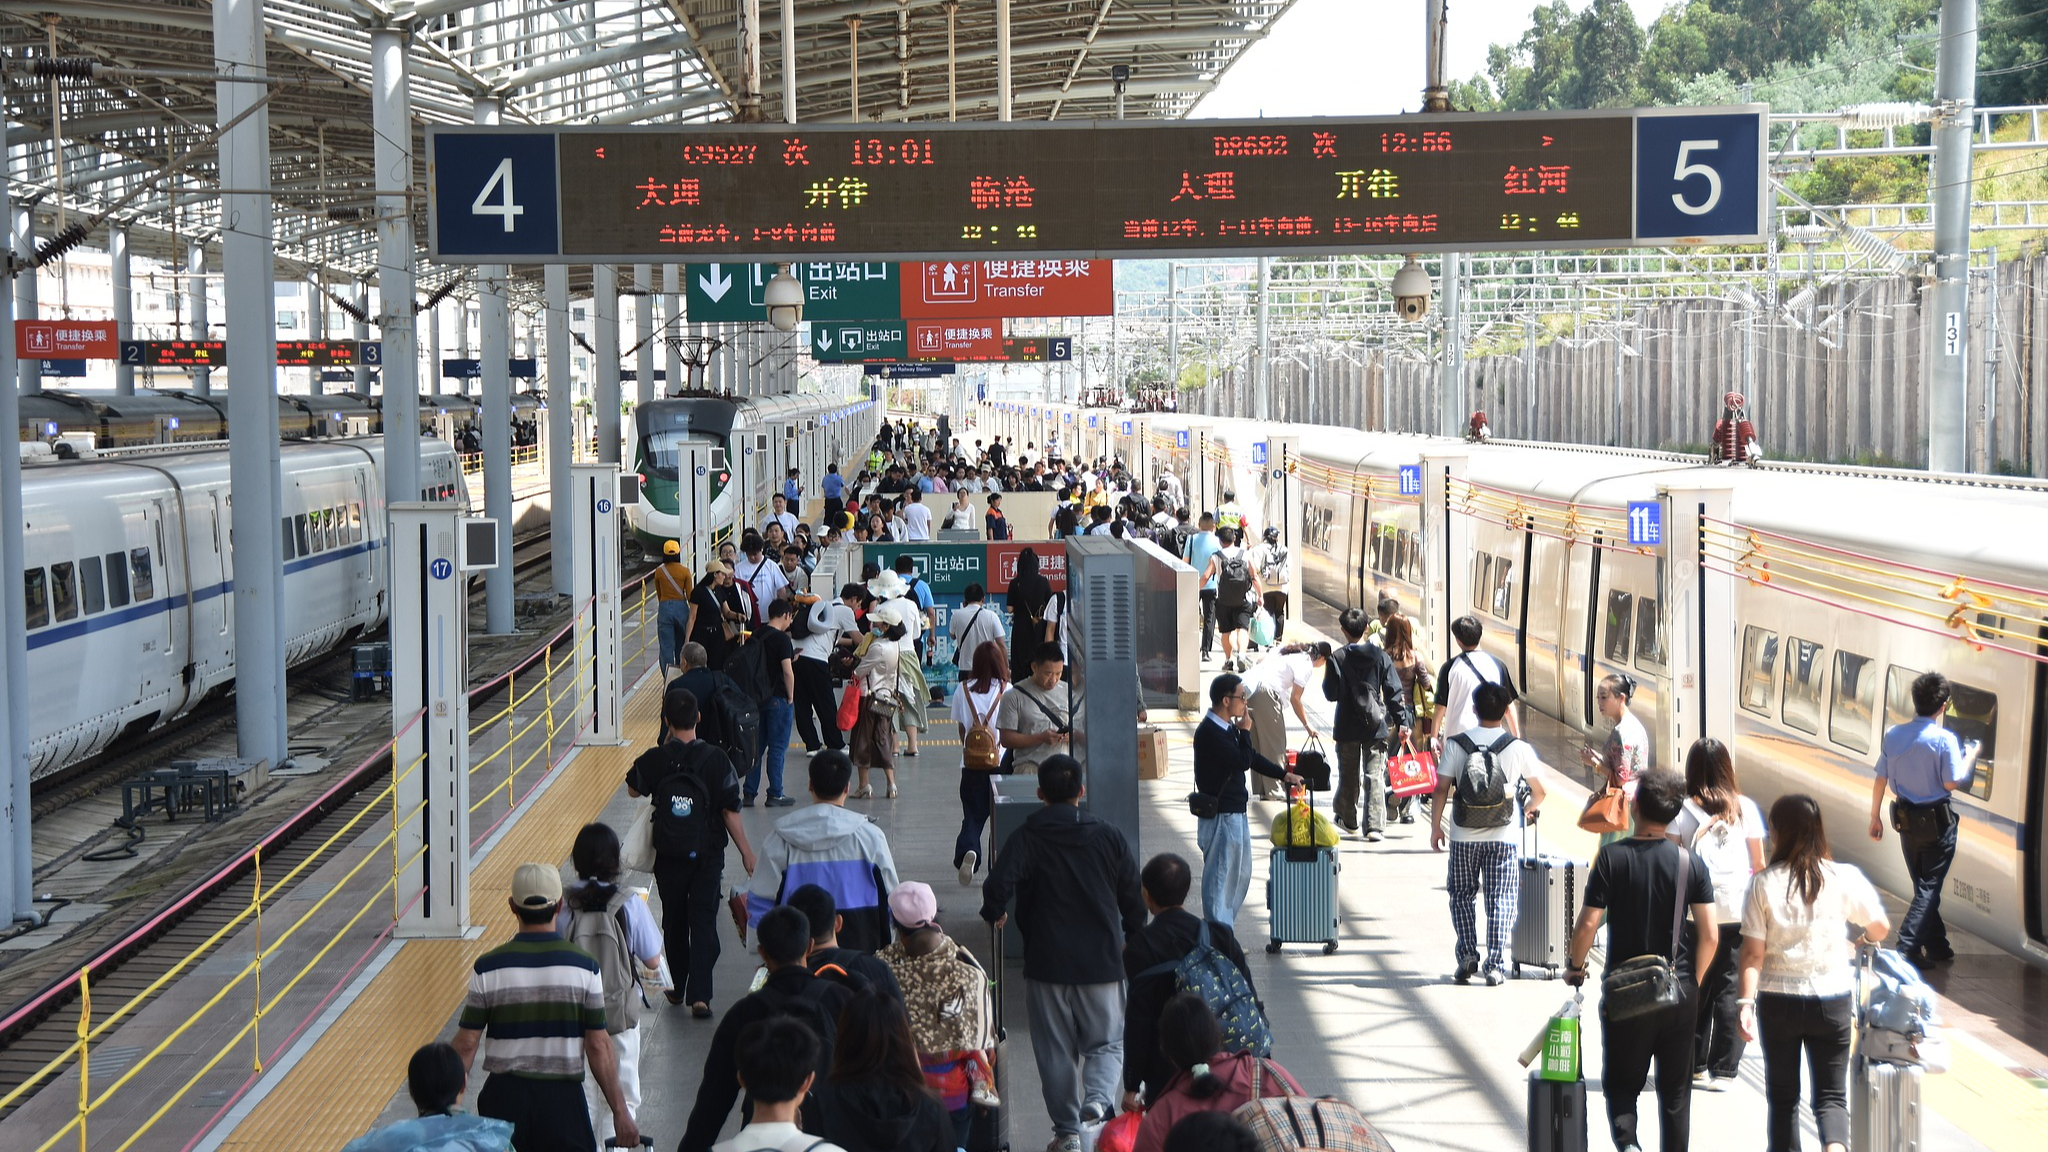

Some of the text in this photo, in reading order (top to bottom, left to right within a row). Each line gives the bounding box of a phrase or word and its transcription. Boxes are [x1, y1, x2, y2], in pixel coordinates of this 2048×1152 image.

[1213, 134, 1288, 156] D8682
[1380, 130, 1451, 152] 12:56
[851, 138, 934, 165] 13:01
[1335, 169, 1400, 198] 开往
[1503, 165, 1570, 194] 红河
[1671, 139, 1722, 216] 5
[472, 157, 524, 232] 4
[635, 176, 699, 210] 大理
[804, 175, 868, 209] 开往
[809, 262, 887, 281] 出站口
[983, 261, 1090, 279] 便捷换乘
[809, 286, 837, 300] Exit
[984, 284, 1045, 298] Transfer
[55, 329, 107, 342] 便捷换乘
[866, 330, 902, 342] 出站口
[944, 327, 993, 340] 便捷换乘
[1947, 313, 1958, 354] 131
[867, 343, 880, 351] Exit
[945, 341, 973, 350] Transfer
[1055, 342, 1066, 357] 5
[127, 346, 138, 361] 2
[367, 346, 377, 361] 3
[697, 467, 705, 475] 15
[1400, 468, 1420, 493] 11车
[599, 501, 609, 512] 16
[1630, 506, 1659, 542] 11车
[433, 561, 448, 577] 17
[934, 556, 980, 571] 出站口
[1037, 555, 1065, 571] 便捷
[934, 573, 951, 583] Exit
[671, 795, 694, 806] NASA
[1549, 1028, 1572, 1043] 云南
